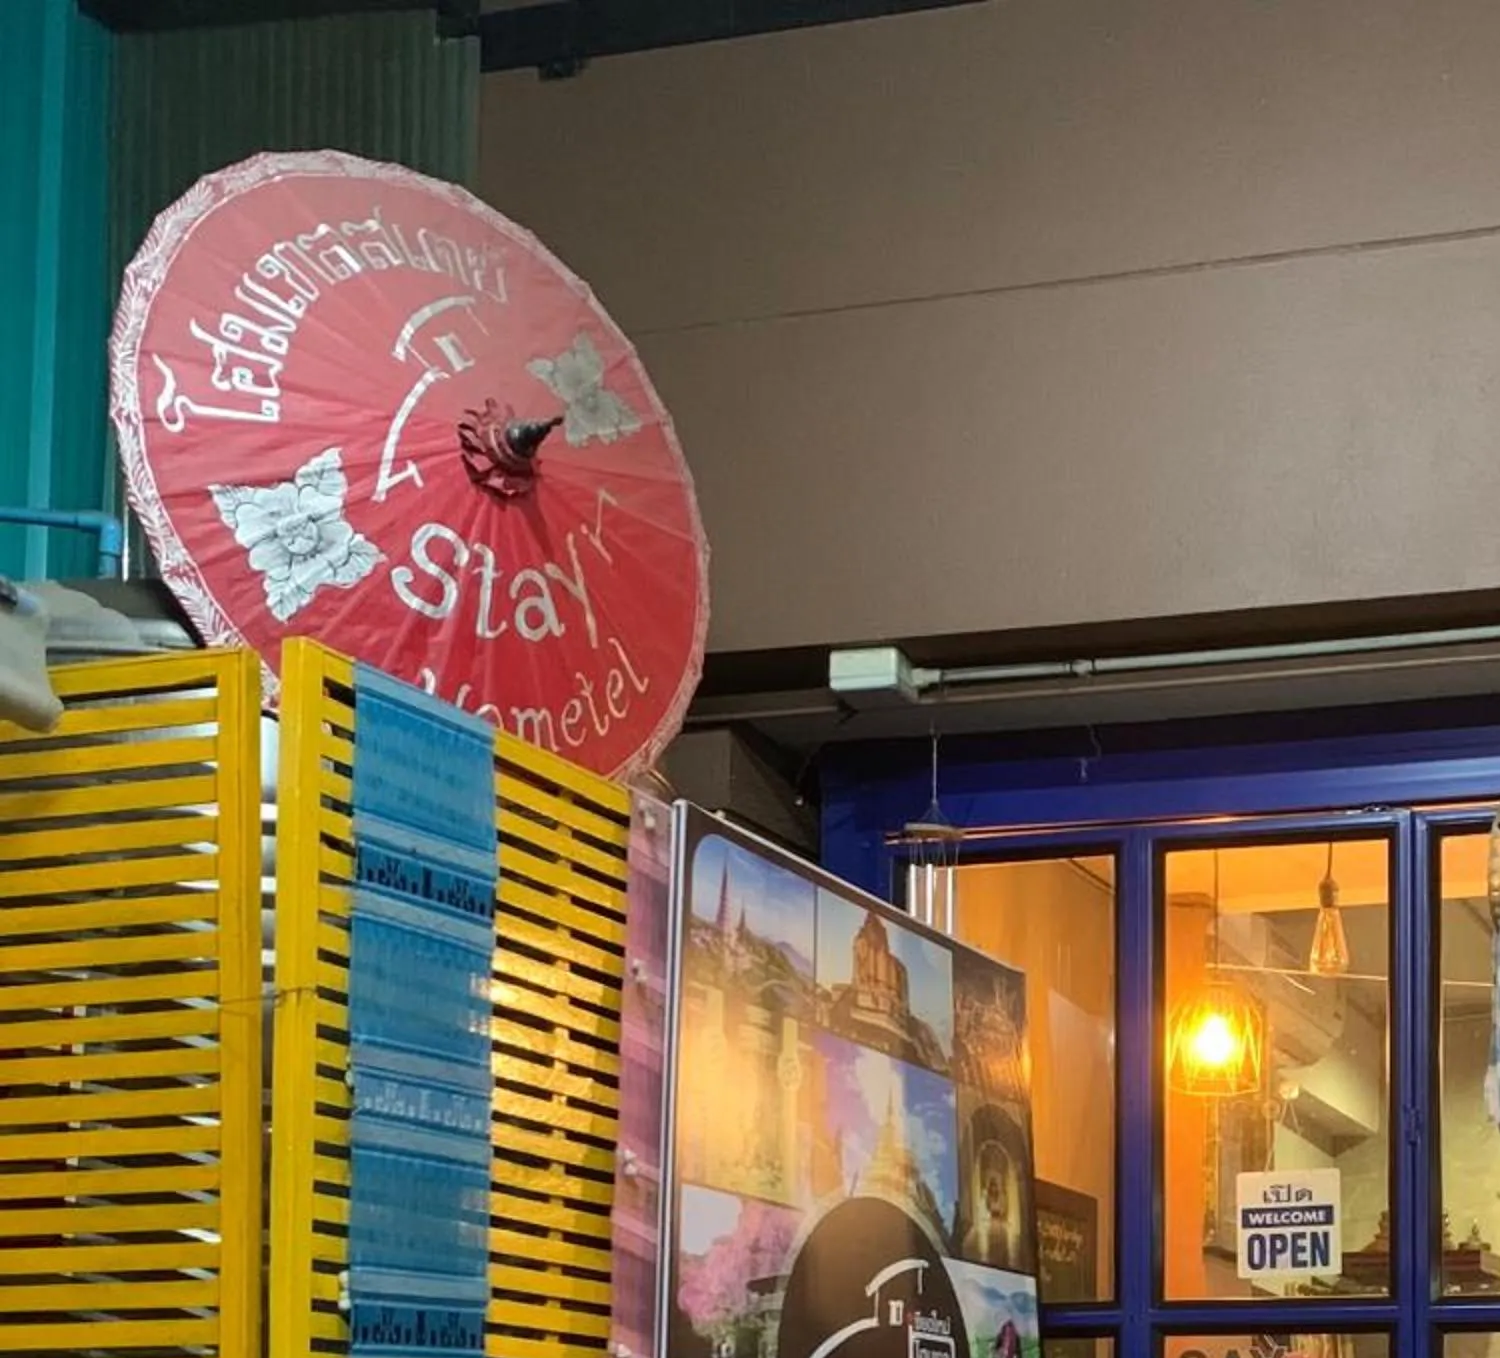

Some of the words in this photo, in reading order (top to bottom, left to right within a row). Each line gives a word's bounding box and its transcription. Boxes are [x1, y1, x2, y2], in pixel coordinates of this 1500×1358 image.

[390, 521, 599, 649] Stay
[414, 637, 650, 753] ometel
[1247, 1231, 1330, 1270] OPEN
[1248, 1210, 1326, 1225] WELCOME
